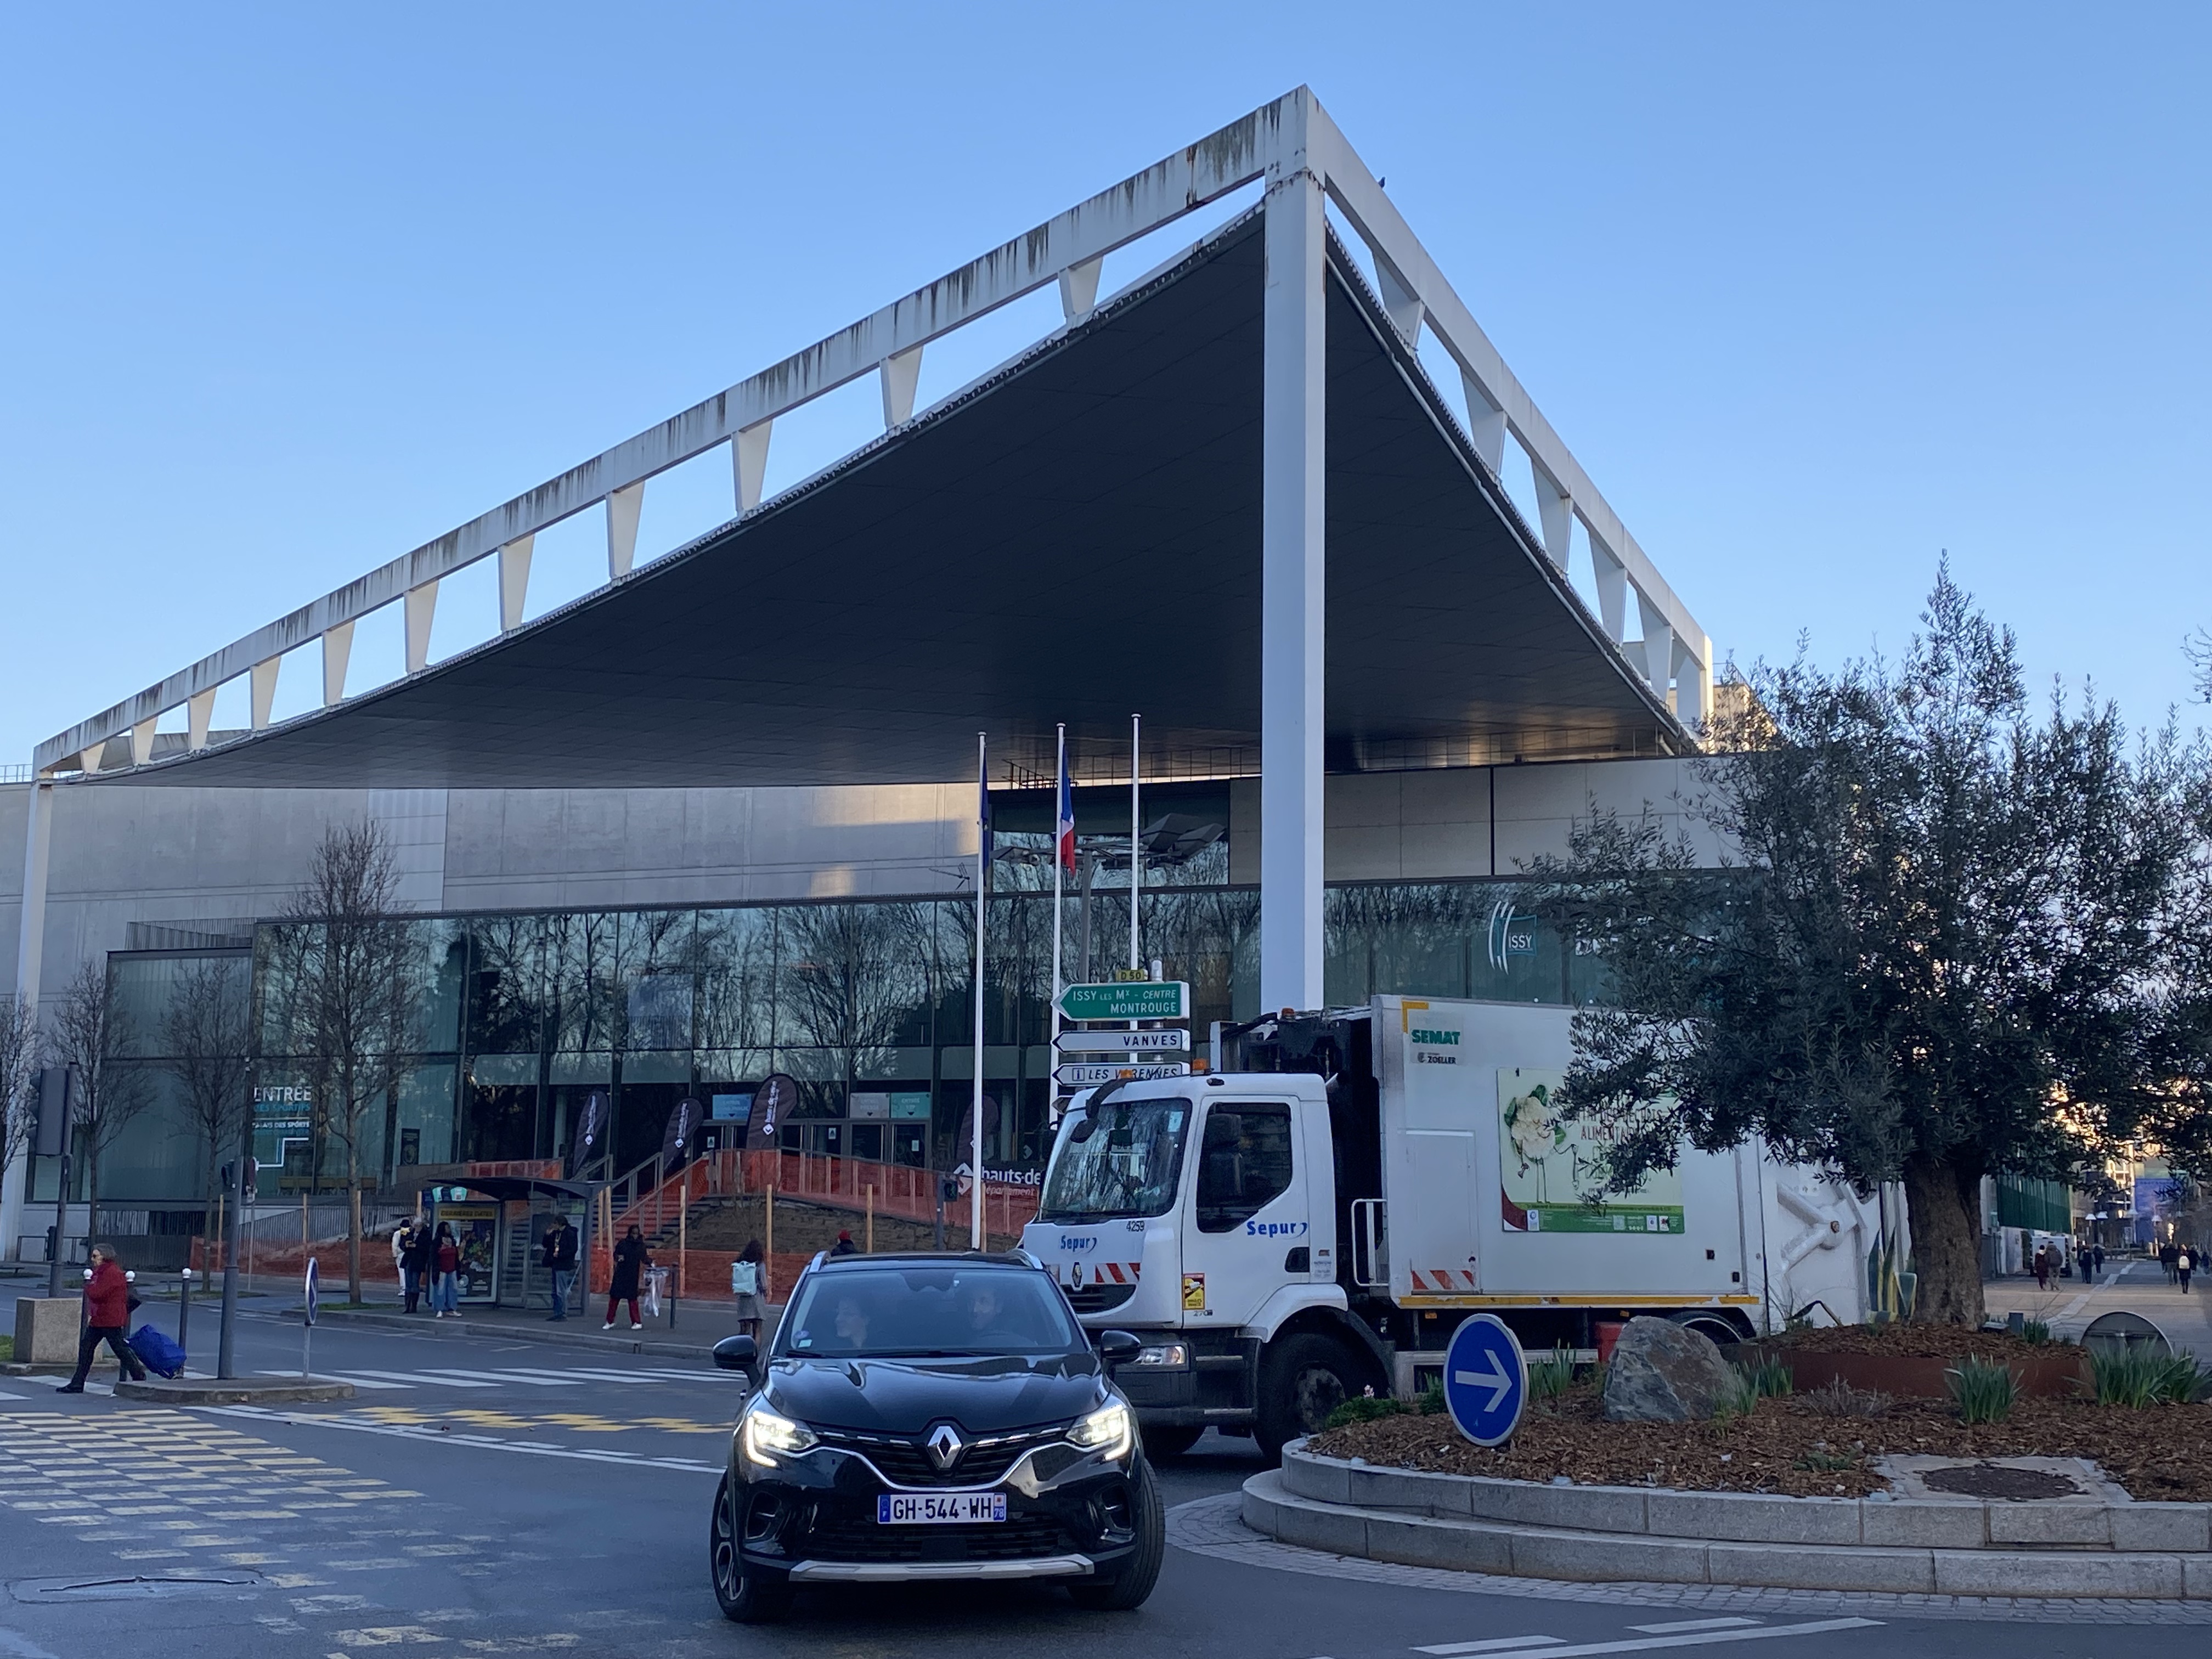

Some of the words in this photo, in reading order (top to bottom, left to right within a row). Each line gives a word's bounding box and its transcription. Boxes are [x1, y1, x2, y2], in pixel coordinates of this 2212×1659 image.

[1509, 934, 1532, 949] ISSY
[1129, 972, 1142, 980] 50
[1073, 990, 1097, 1001] ISSY
[1143, 989, 1177, 1000] CENTRE
[1110, 1002, 1177, 1014] MONTROUGE
[1123, 1035, 1177, 1046] VANVES
[1411, 1029, 1460, 1045] SEMAT
[1427, 1056, 1457, 1064] ZOELLER
[1088, 1069, 1109, 1080] LES
[1115, 1068, 1177, 1080] VRENNES
[1126, 1221, 1145, 1232] 4259
[1246, 1220, 1299, 1238] Sepur
[1060, 1235, 1093, 1252] Sepur
[893, 1497, 992, 1520] GH-544-WH
[994, 1508, 1005, 1519] 78
